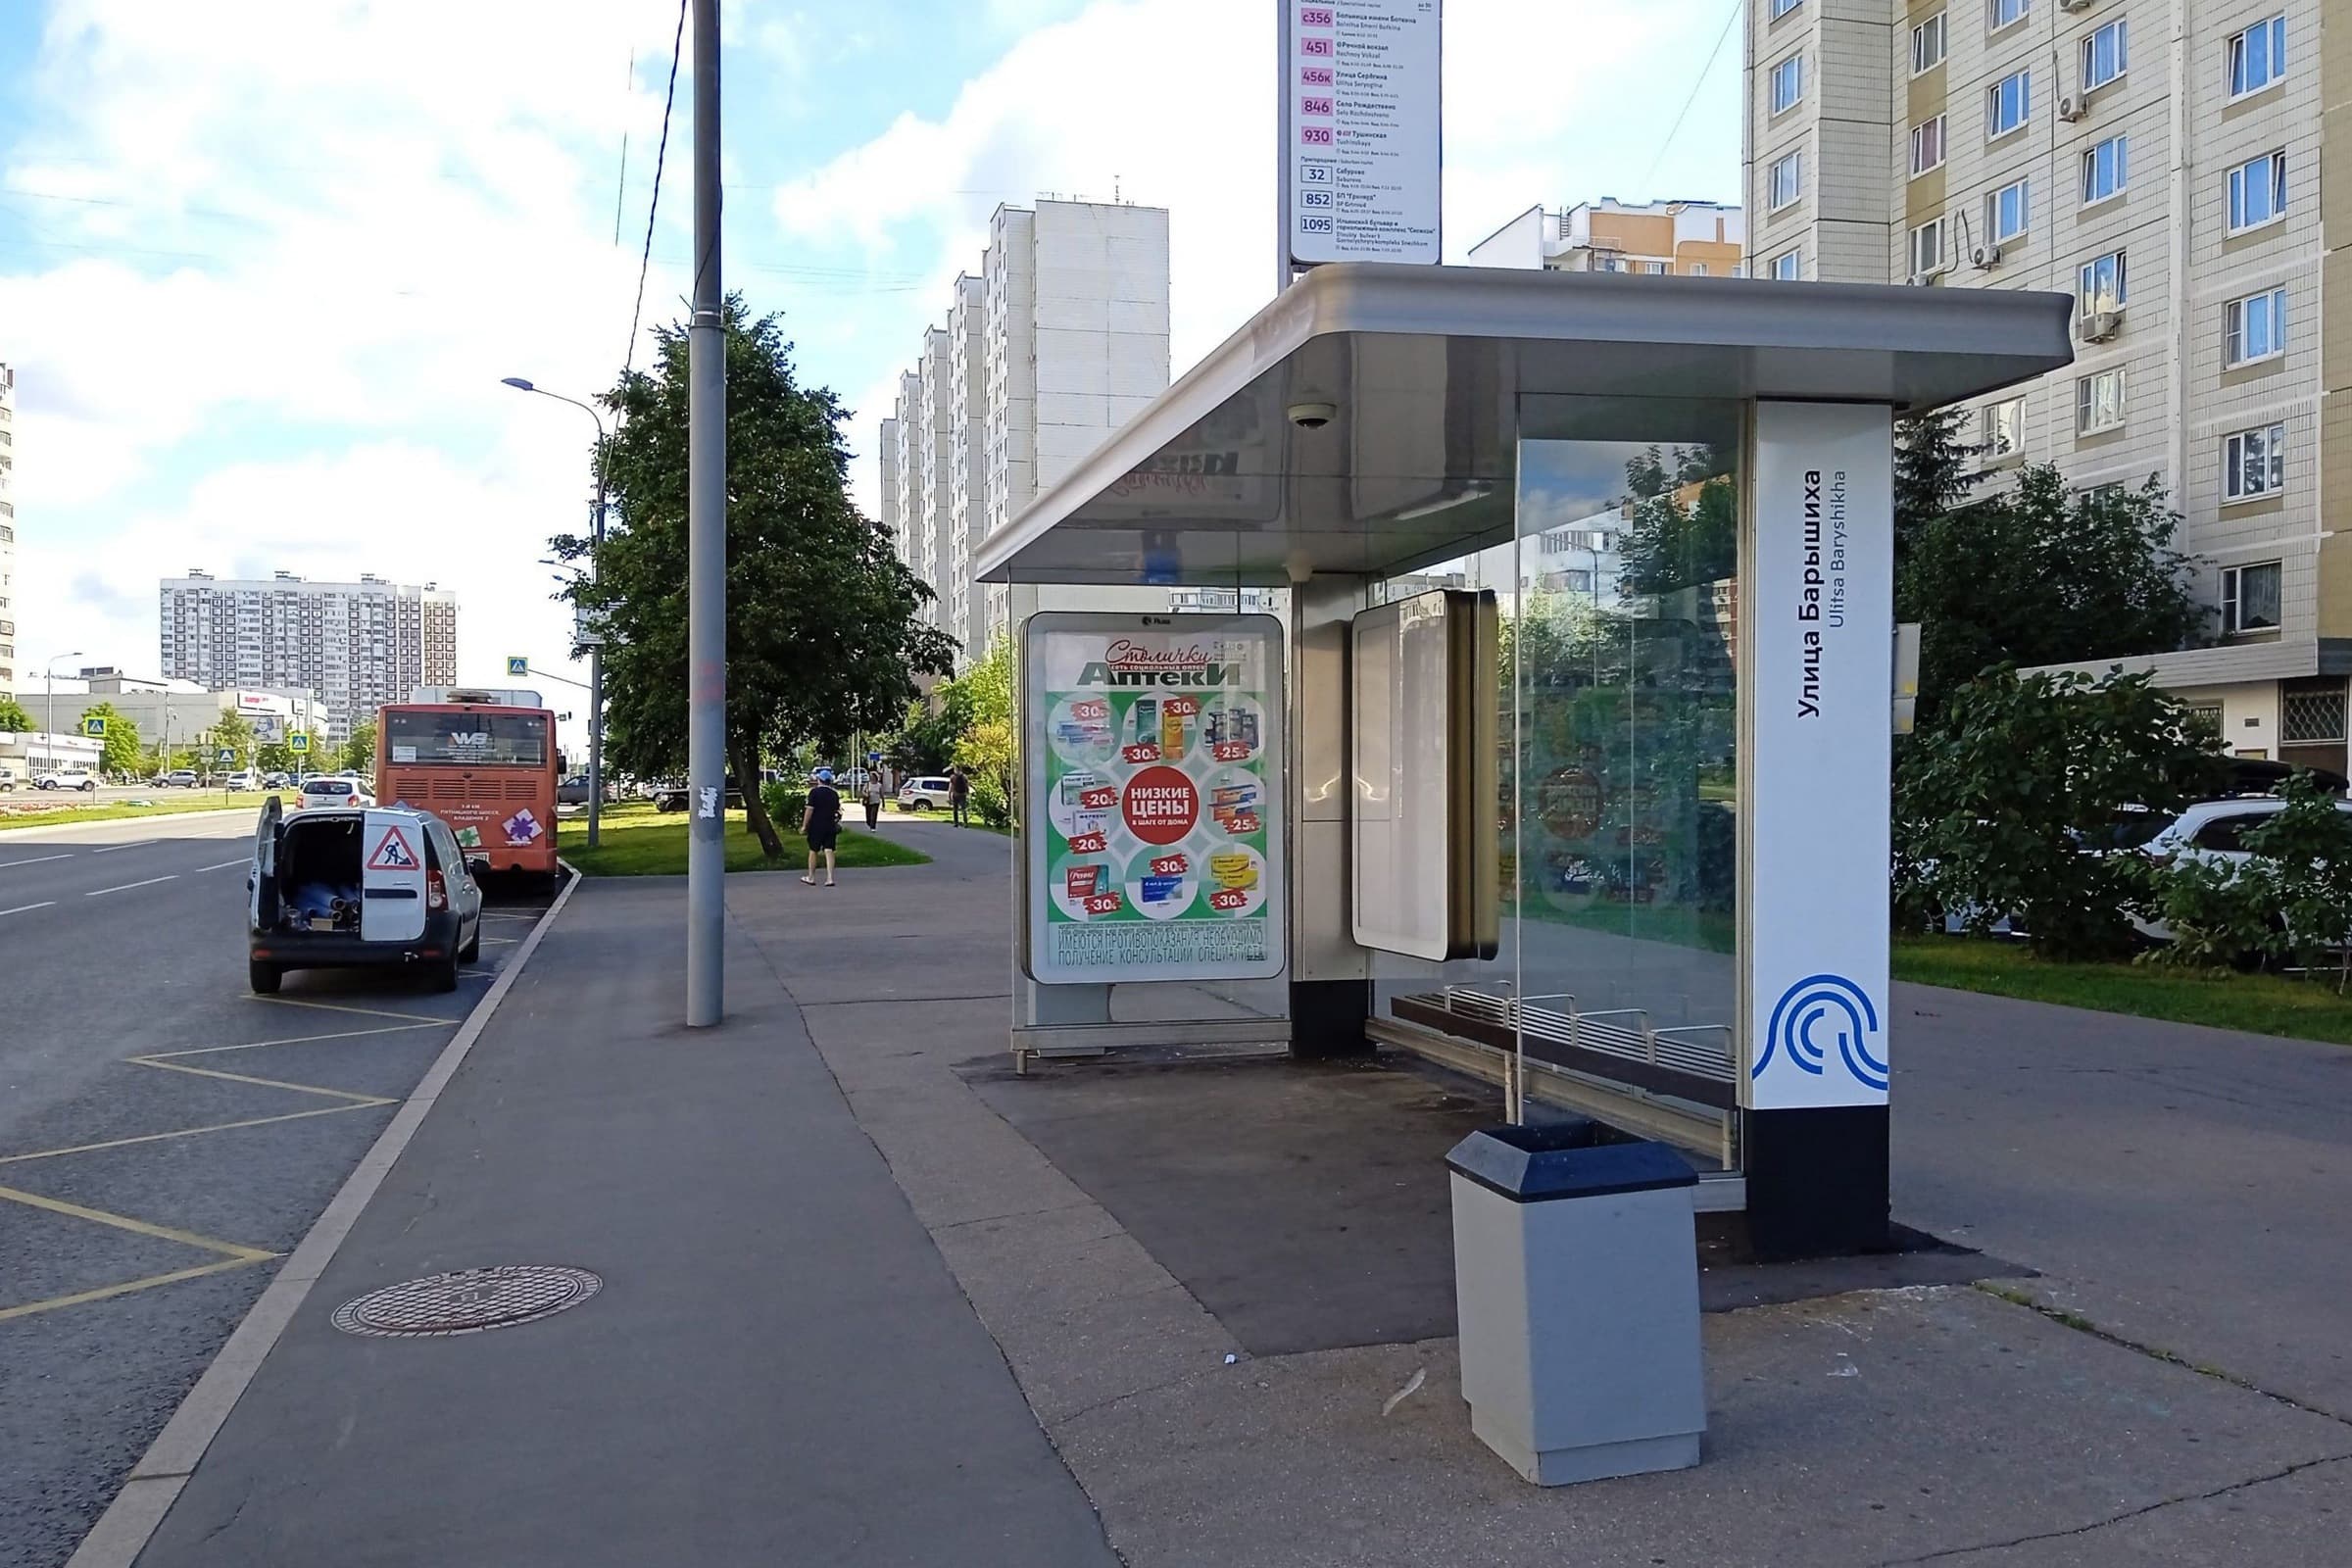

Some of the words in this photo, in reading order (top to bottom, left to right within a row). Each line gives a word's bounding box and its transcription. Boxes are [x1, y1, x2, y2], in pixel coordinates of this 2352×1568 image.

[1306, 41, 1327, 54] 451
[1304, 100, 1329, 113] 846
[1304, 129, 1329, 142] 930
[1308, 169, 1325, 180] 32
[1306, 193, 1330, 206] 852
[1302, 219, 1331, 231] 1095
[1830, 470, 1849, 571] Baryshikha
[1798, 469, 1825, 621] Барышиха
[1830, 577, 1845, 628] Ulitsa
[1104, 639, 1212, 663] Столички
[1797, 630, 1823, 717] Улица
[1130, 787, 1190, 799] НИЗКИЕ
[1132, 800, 1190, 816] ЦЕНЫ
[1167, 818, 1188, 827] ДОМА
[1058, 933, 1102, 950] ИМЕЮТСЯ
[1058, 948, 1114, 965] ПОЛУЧЕНИЕ
[1119, 947, 1193, 963] КОНСУЛЬТАЦИИ
